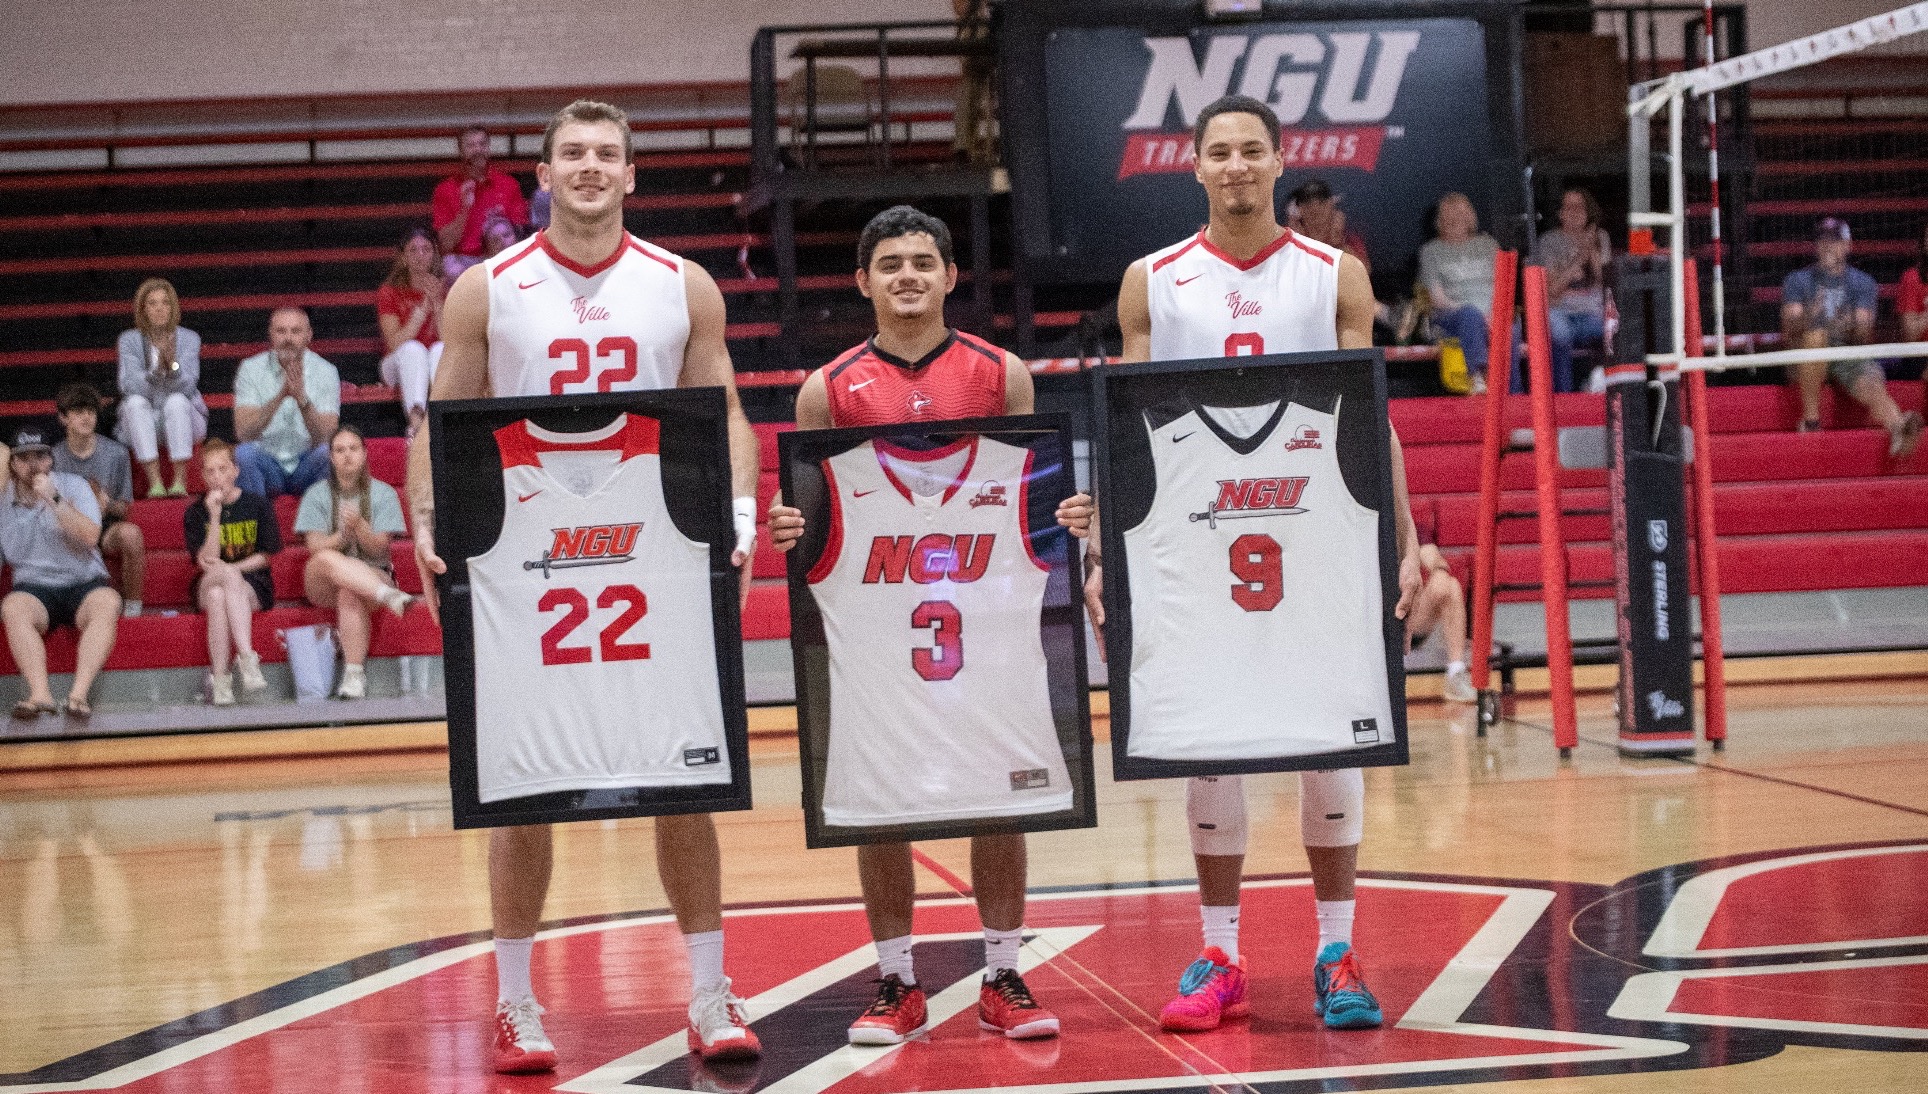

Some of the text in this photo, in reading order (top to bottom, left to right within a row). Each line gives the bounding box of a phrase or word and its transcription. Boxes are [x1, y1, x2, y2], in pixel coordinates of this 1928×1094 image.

[1122, 31, 1421, 129] NGU
[1143, 134, 1360, 166] TRAZERS
[571, 296, 587, 312] The
[576, 306, 611, 324] Ville
[1225, 290, 1241, 306] The
[1231, 301, 1263, 319] Ville
[548, 336, 638, 395] 22
[1214, 477, 1310, 511] NGU
[549, 522, 644, 559] NGU
[862, 533, 996, 584] NGU
[1229, 533, 1284, 612] 9
[538, 584, 651, 666] 22
[911, 600, 964, 682] 3
